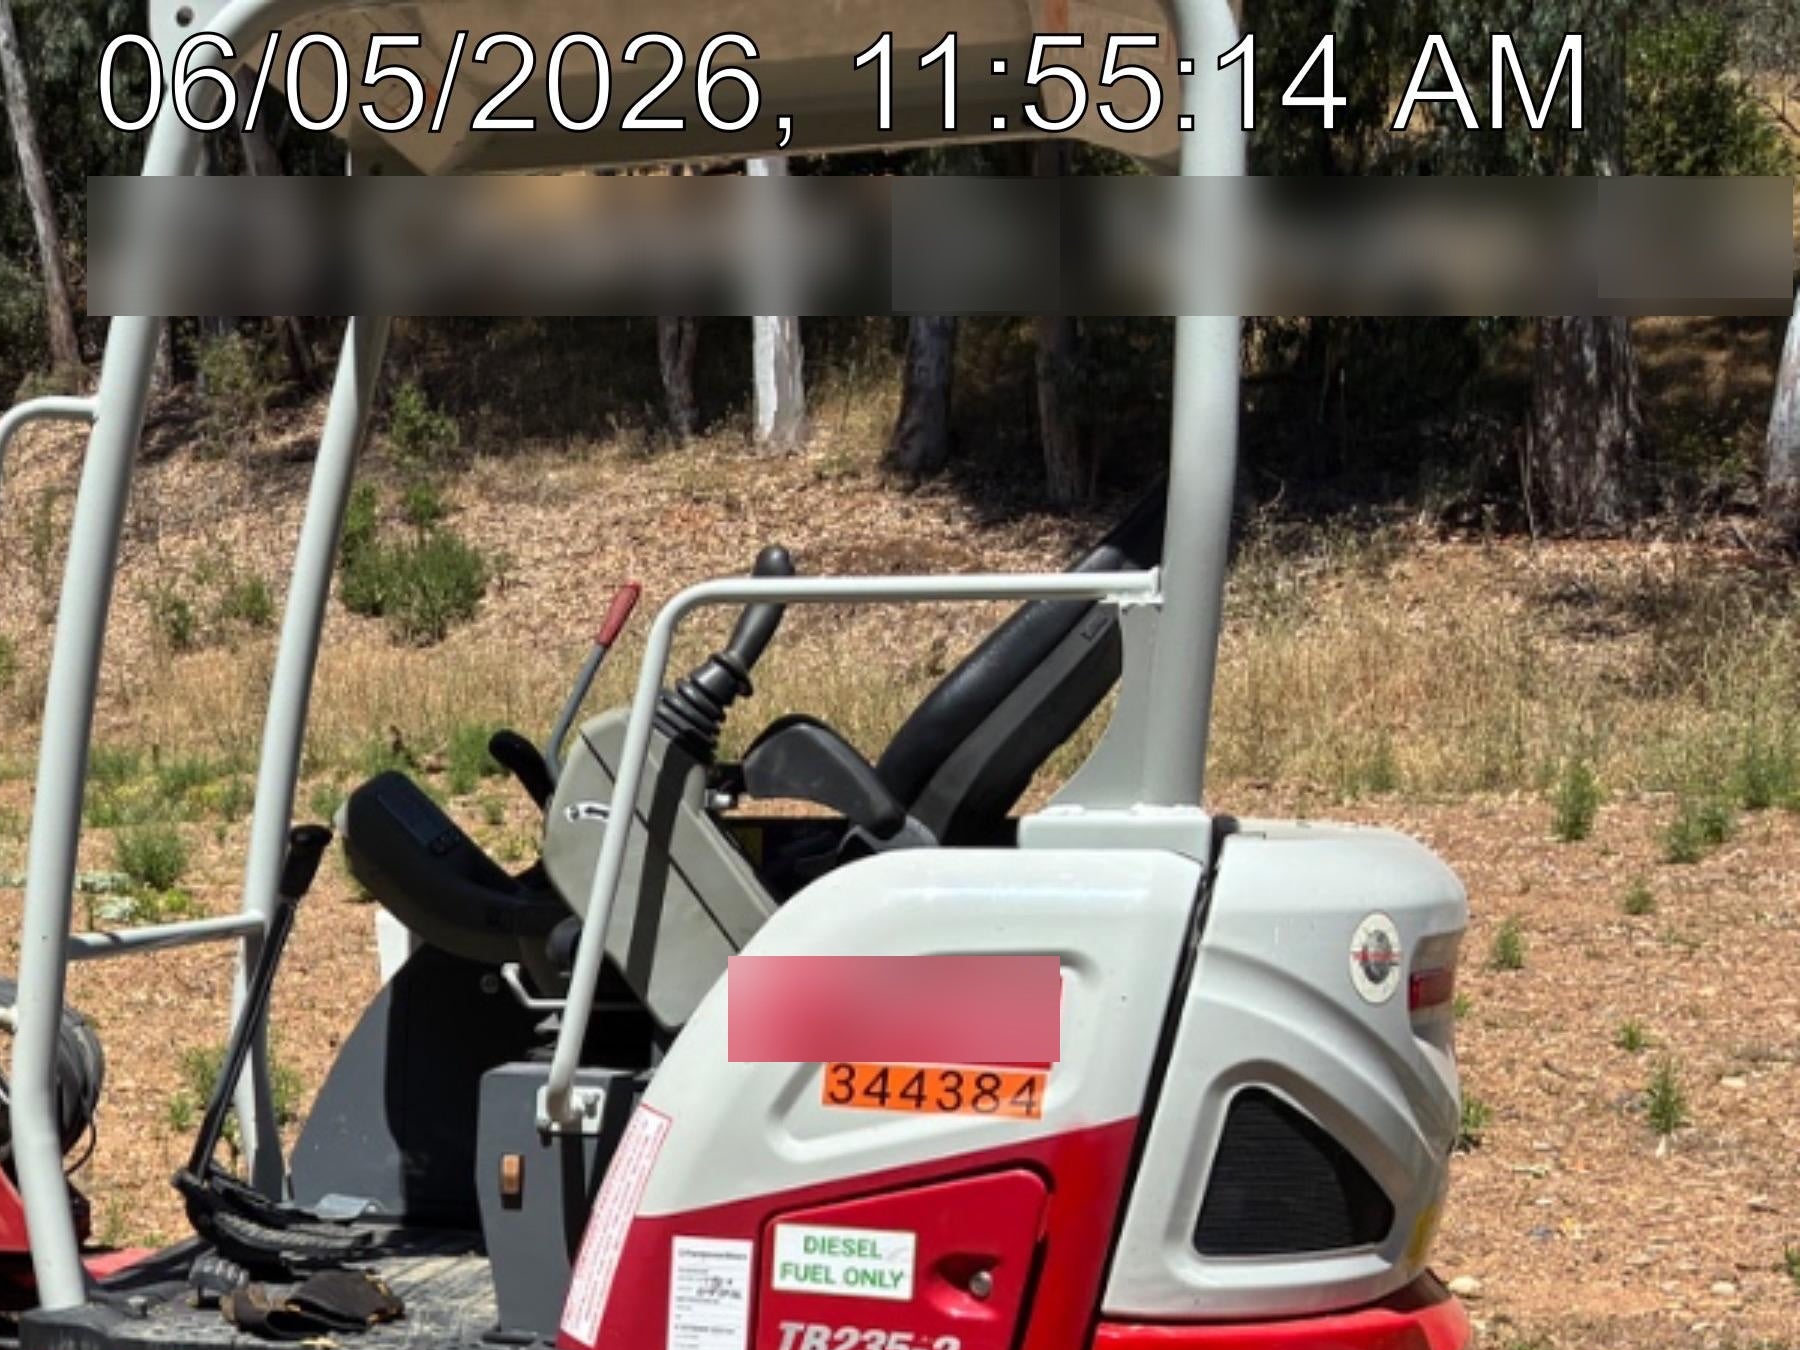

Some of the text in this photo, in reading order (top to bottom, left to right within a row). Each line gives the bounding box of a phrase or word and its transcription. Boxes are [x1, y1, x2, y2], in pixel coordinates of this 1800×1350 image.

[829, 1062, 1037, 1116] 344384
[803, 1235, 882, 1260] DIESEL
[779, 1262, 904, 1290] FUEL ONLY
